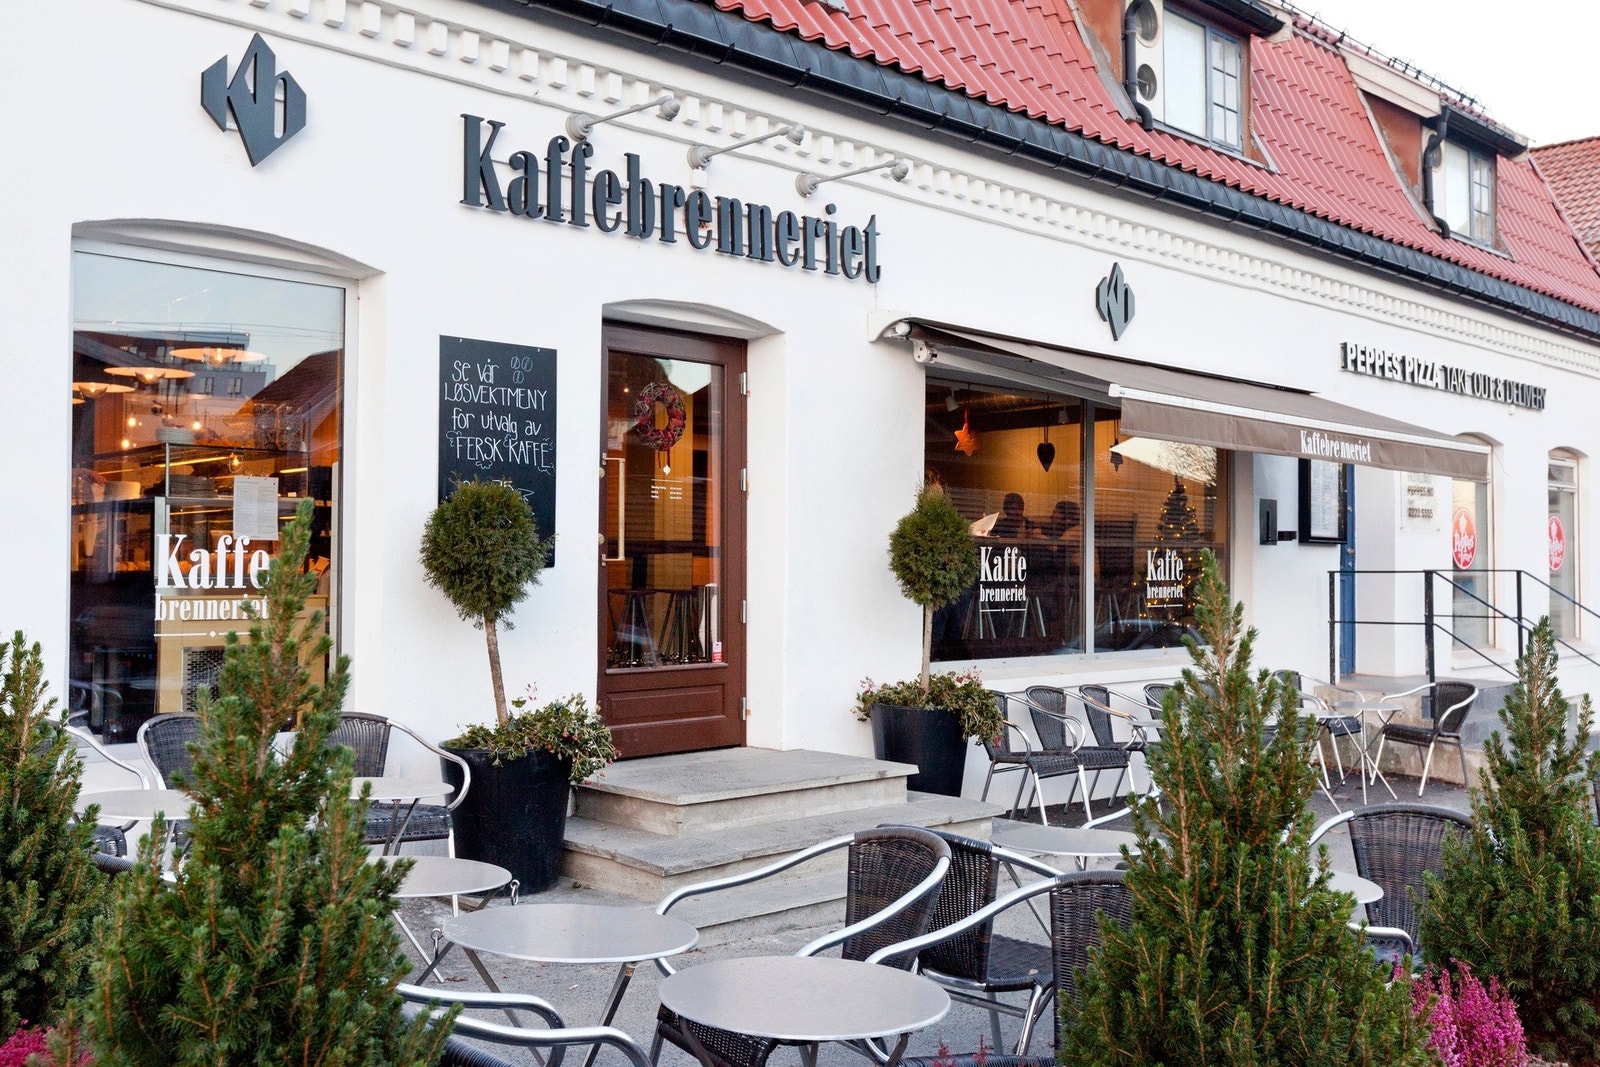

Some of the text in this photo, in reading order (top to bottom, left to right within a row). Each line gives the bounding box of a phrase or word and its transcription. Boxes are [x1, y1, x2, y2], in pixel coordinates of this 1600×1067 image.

[460, 113, 881, 284] Kaffebrenneriet
[477, 358, 500, 384] vår
[1340, 342, 1402, 380] PEPPES
[1402, 356, 1440, 389] PIZZA
[1504, 380, 1546, 410] DELIVERY
[444, 382, 547, 411] LØSVEKTMENY
[452, 407, 541, 441] for utvalg av
[456, 436, 504, 462] FERSK
[1301, 430, 1371, 463] Kaffebrenneriet
[155, 534, 270, 589] Kaffe
[980, 546, 1027, 582] Kaffe
[1146, 549, 1184, 581] Kaffe
[155, 593, 270, 621] brenneriet
[980, 584, 1027, 602] brenneriet
[1146, 583, 1184, 599] brenneriet
